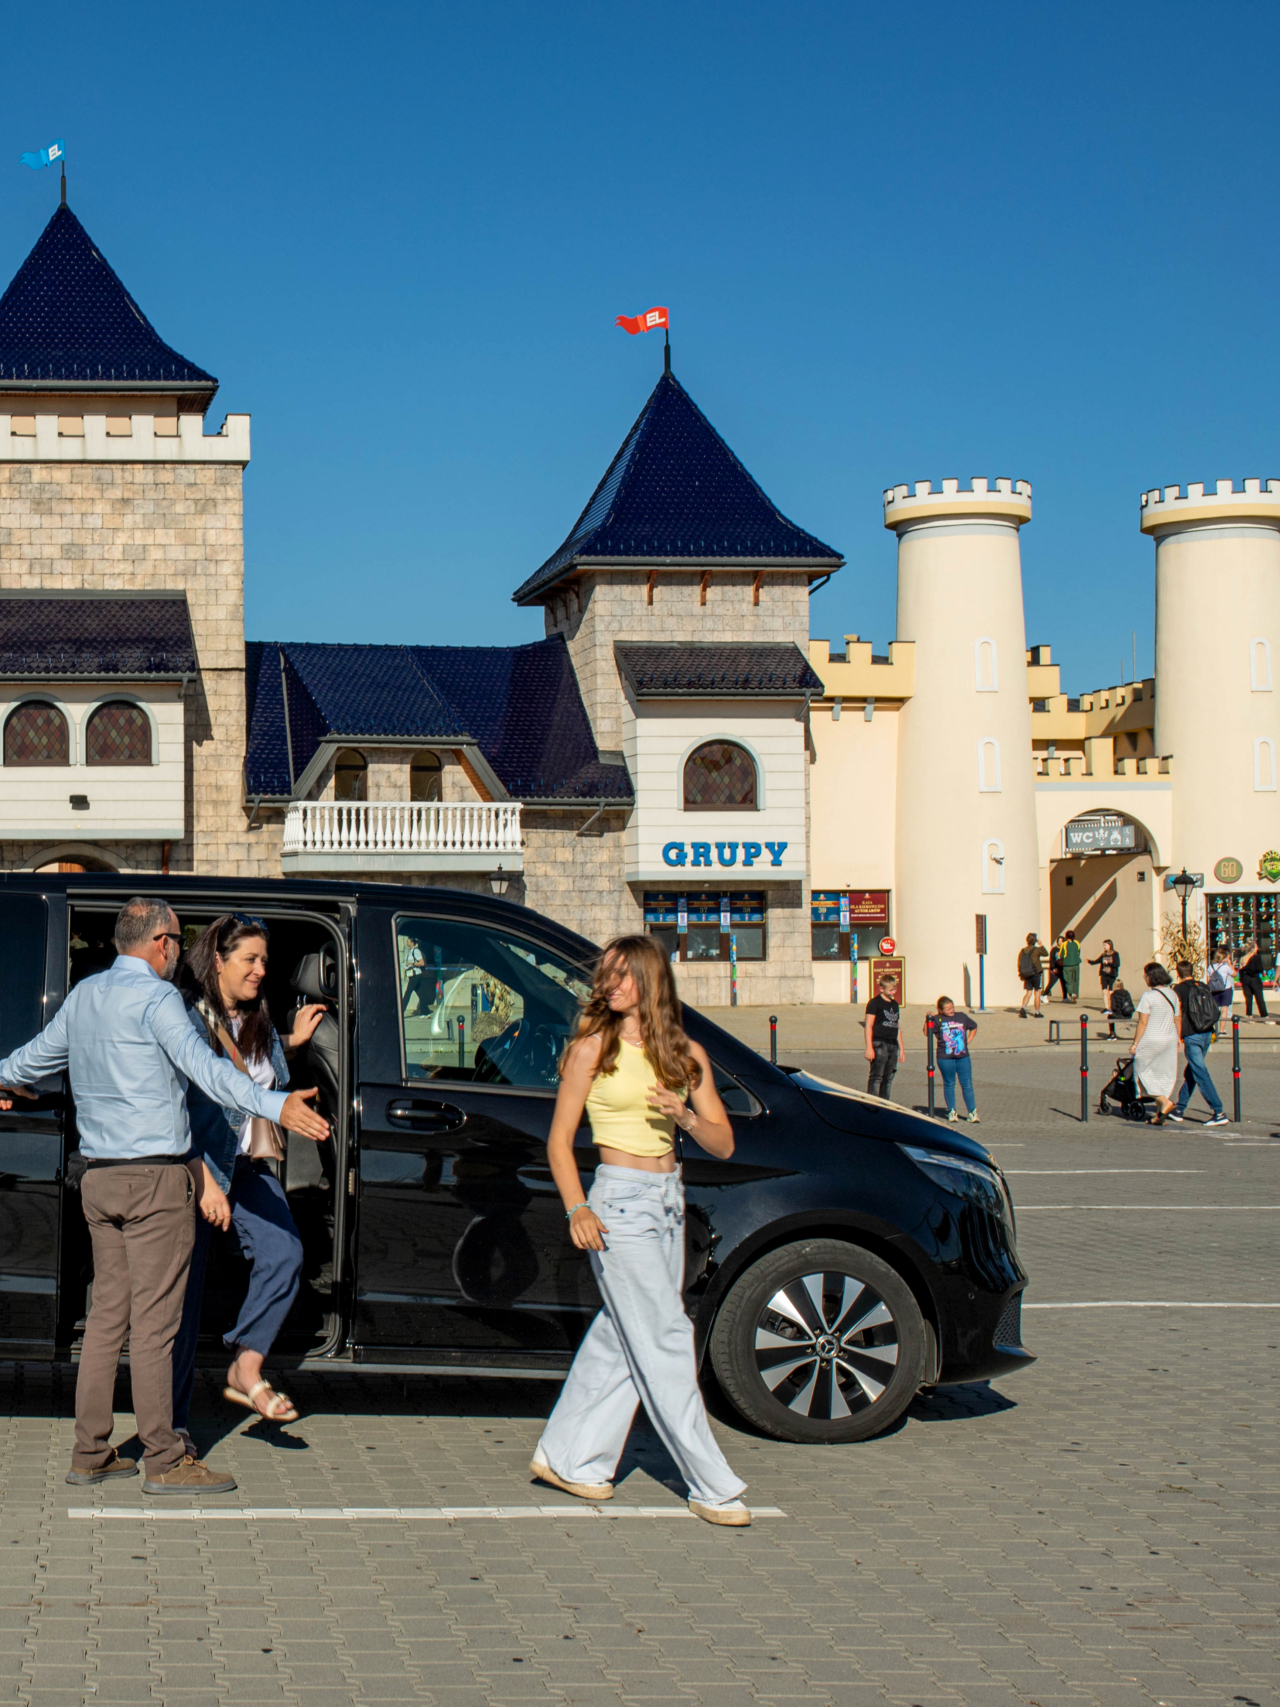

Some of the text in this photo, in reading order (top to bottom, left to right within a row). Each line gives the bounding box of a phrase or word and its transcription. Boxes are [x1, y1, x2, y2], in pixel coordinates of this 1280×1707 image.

[48, 143, 62, 161] EL
[646, 310, 666, 327] EL
[1070, 832, 1093, 843] WC
[661, 841, 788, 866] GRUPY
[1221, 862, 1237, 878] 60
